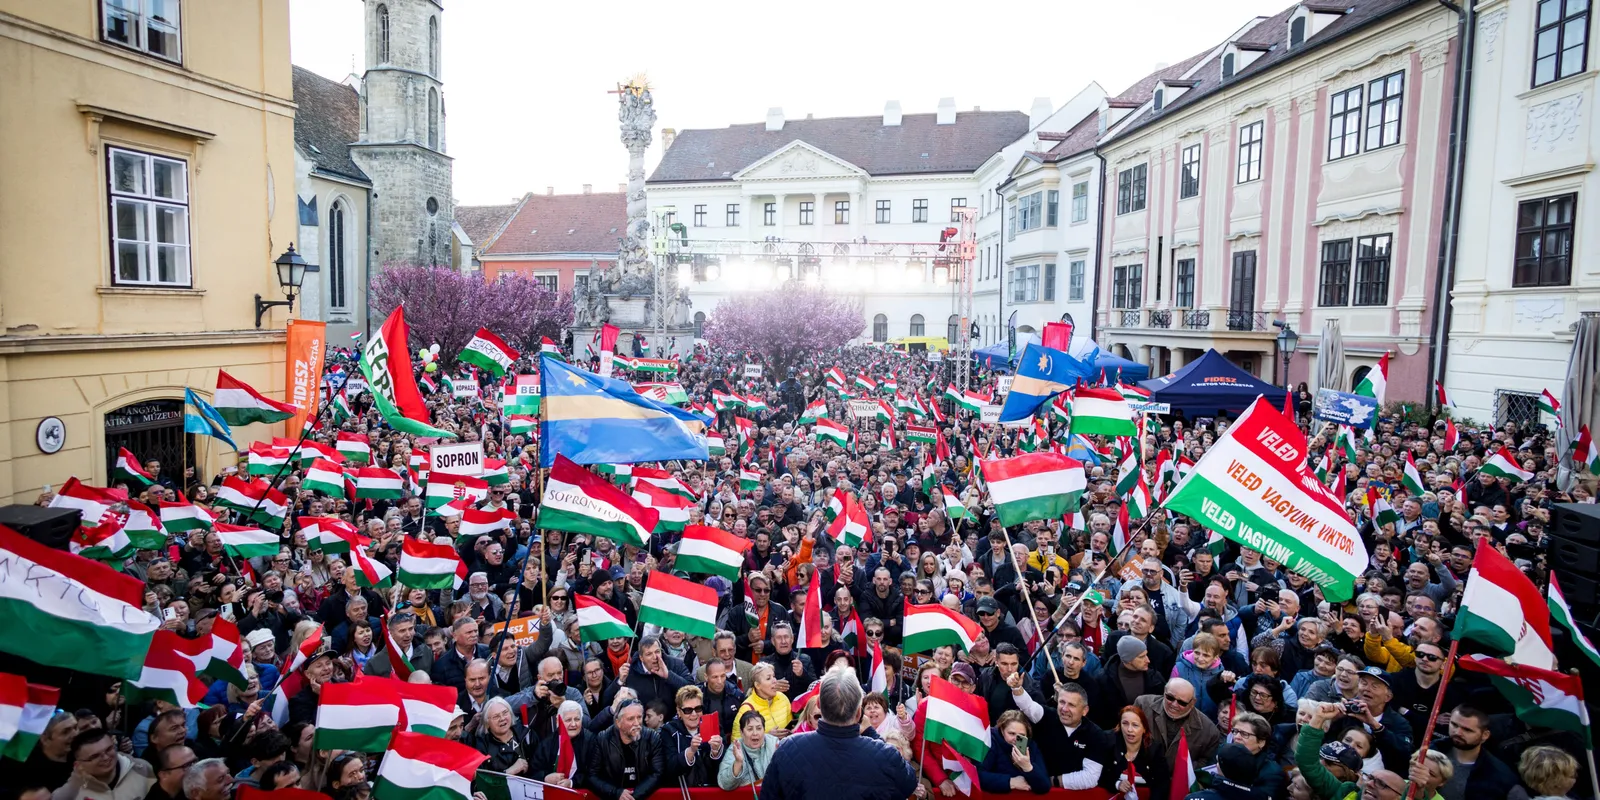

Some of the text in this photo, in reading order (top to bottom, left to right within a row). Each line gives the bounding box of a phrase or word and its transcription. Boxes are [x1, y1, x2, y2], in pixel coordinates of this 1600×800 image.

[293, 360, 308, 409] FIDESZ
[105, 410, 181, 427] ATIKA MÚZEUM
[126, 404, 161, 416] ANGYAL
[436, 451, 479, 468] SOPRON
[1256, 426, 1299, 462] VELED
[1226, 459, 1263, 491] VELED
[1261, 486, 1319, 533] VAGYUNK
[1317, 524, 1355, 556] VIKTOR!
[1200, 497, 1340, 587] VELED VAGYUNK VIKTOR!
